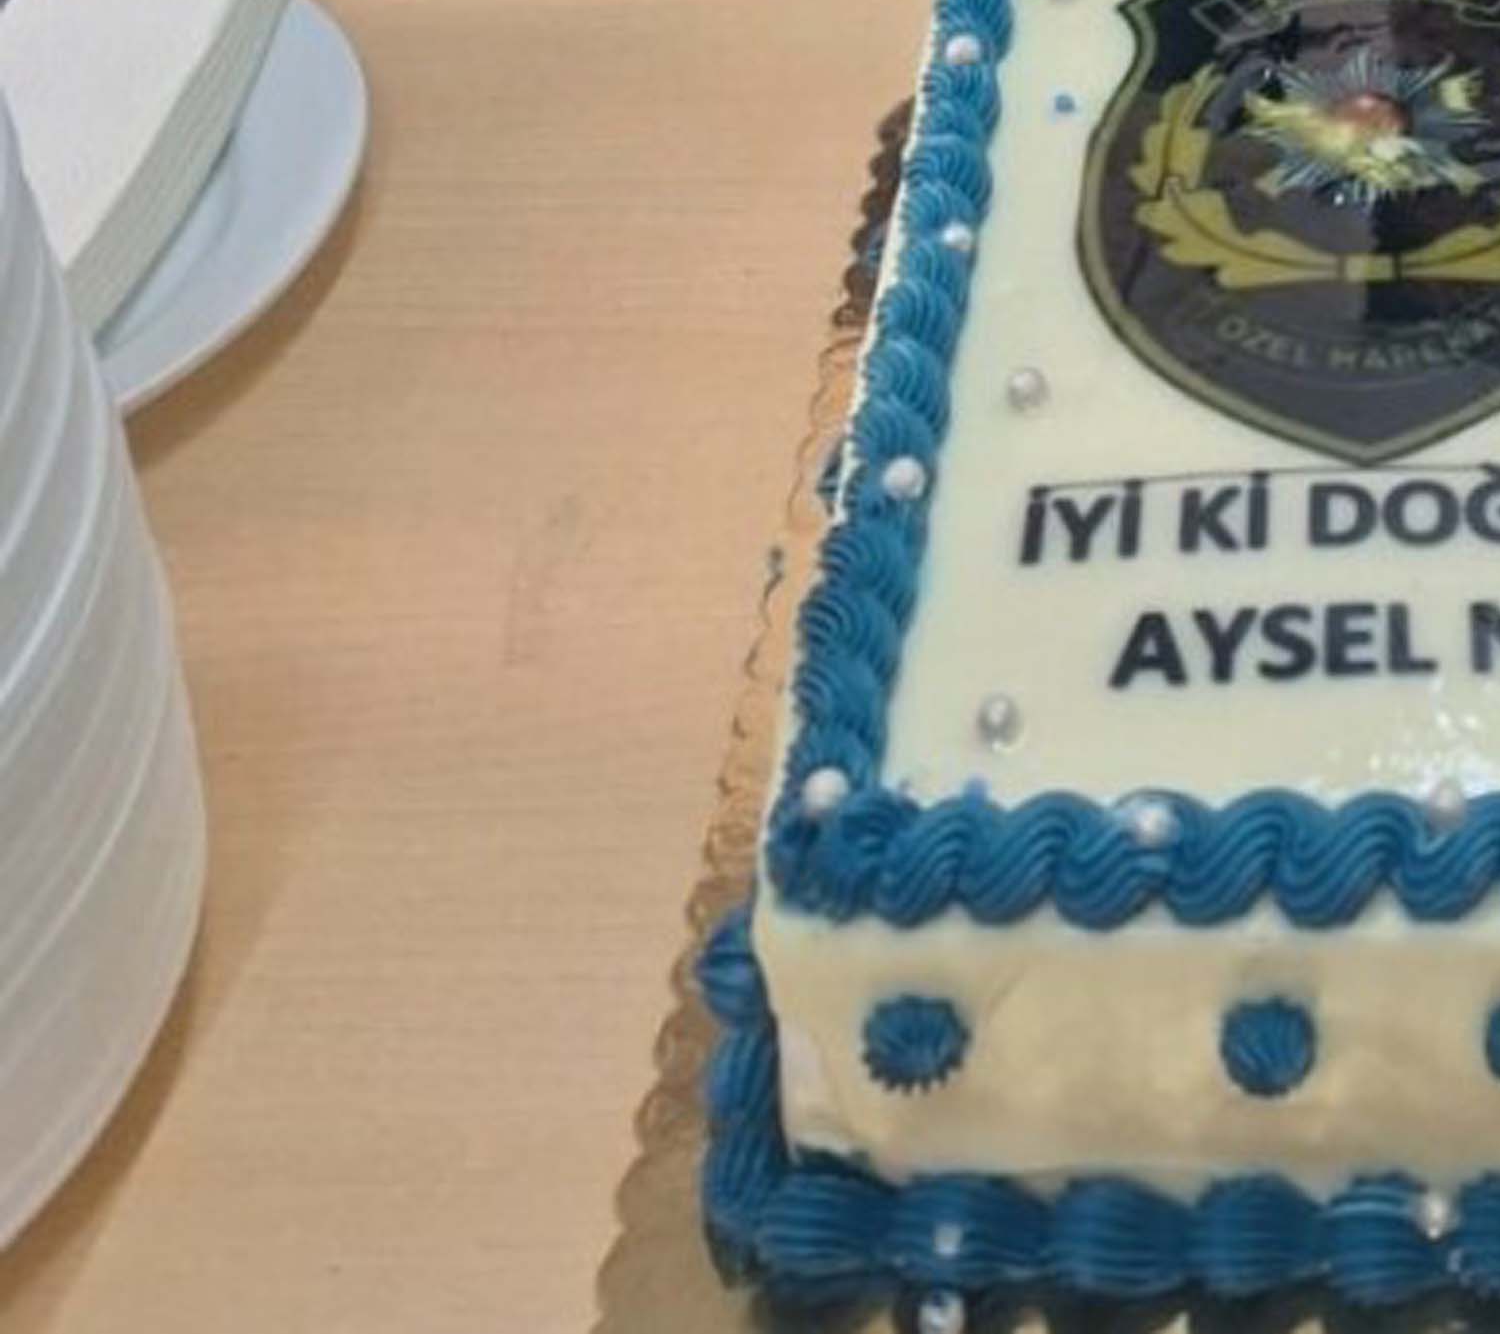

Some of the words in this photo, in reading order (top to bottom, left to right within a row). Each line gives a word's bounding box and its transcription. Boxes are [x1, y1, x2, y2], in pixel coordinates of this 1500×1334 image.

[1018, 481, 1142, 566] İYİ
[1180, 471, 1269, 551] Kİ
[1108, 603, 1438, 690] AYSEL
